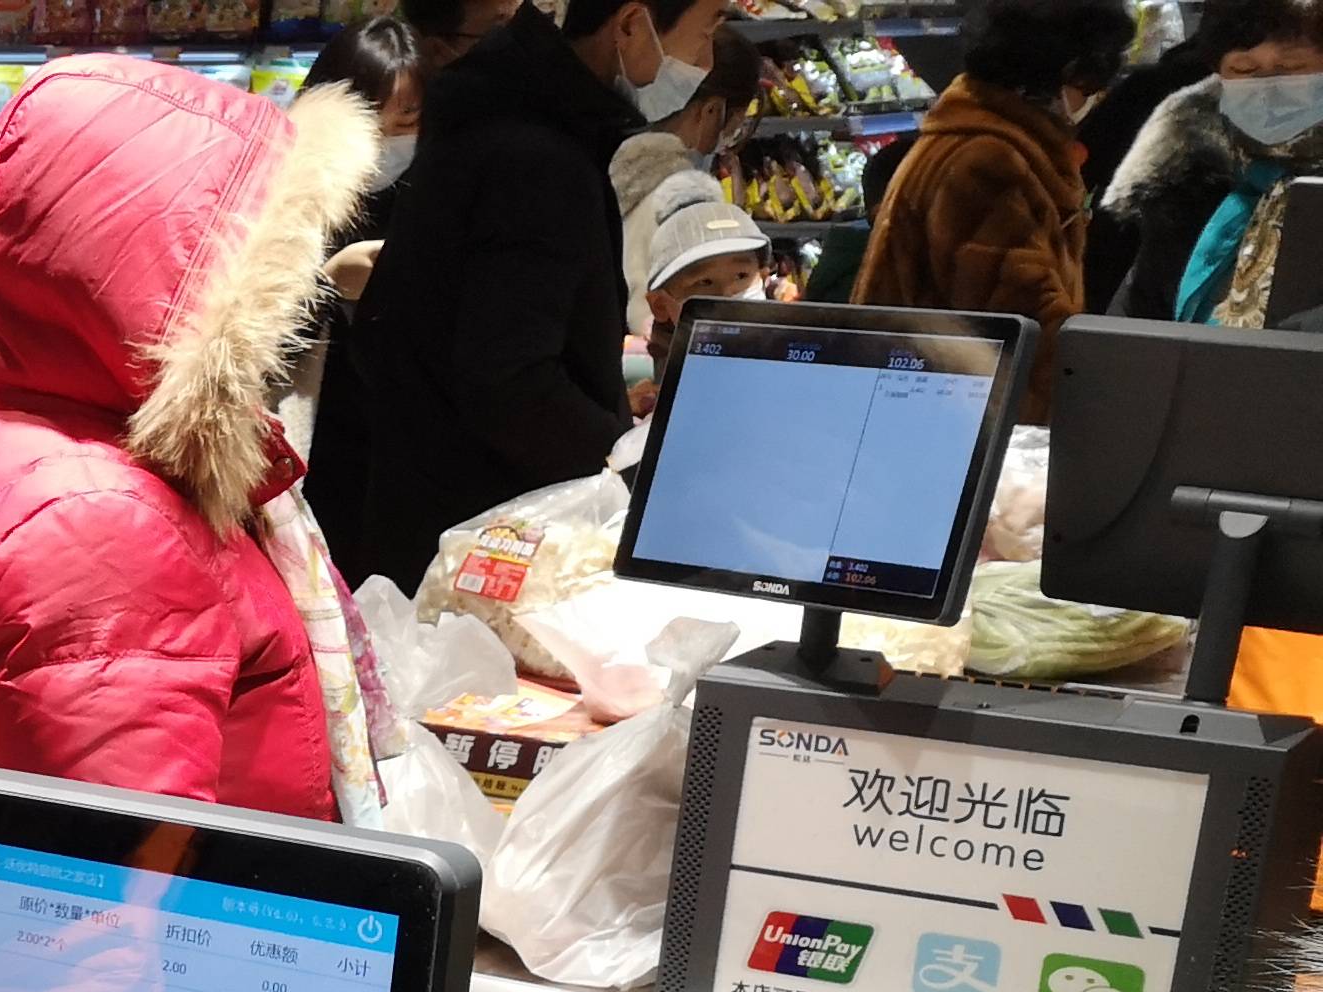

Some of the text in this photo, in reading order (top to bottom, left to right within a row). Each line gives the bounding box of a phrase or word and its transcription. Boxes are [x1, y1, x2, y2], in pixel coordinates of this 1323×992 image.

[759, 728, 849, 756] SONDA
[842, 767, 1070, 839] 欢迎光临
[854, 820, 1045, 871] welcome
[165, 923, 213, 948] 折扣价
[249, 939, 299, 965] 优惠额
[337, 956, 371, 978] 小计
[763, 924, 862, 961] UnionPay
[162, 959, 187, 976] 2.00
[797, 950, 850, 974] 银联
